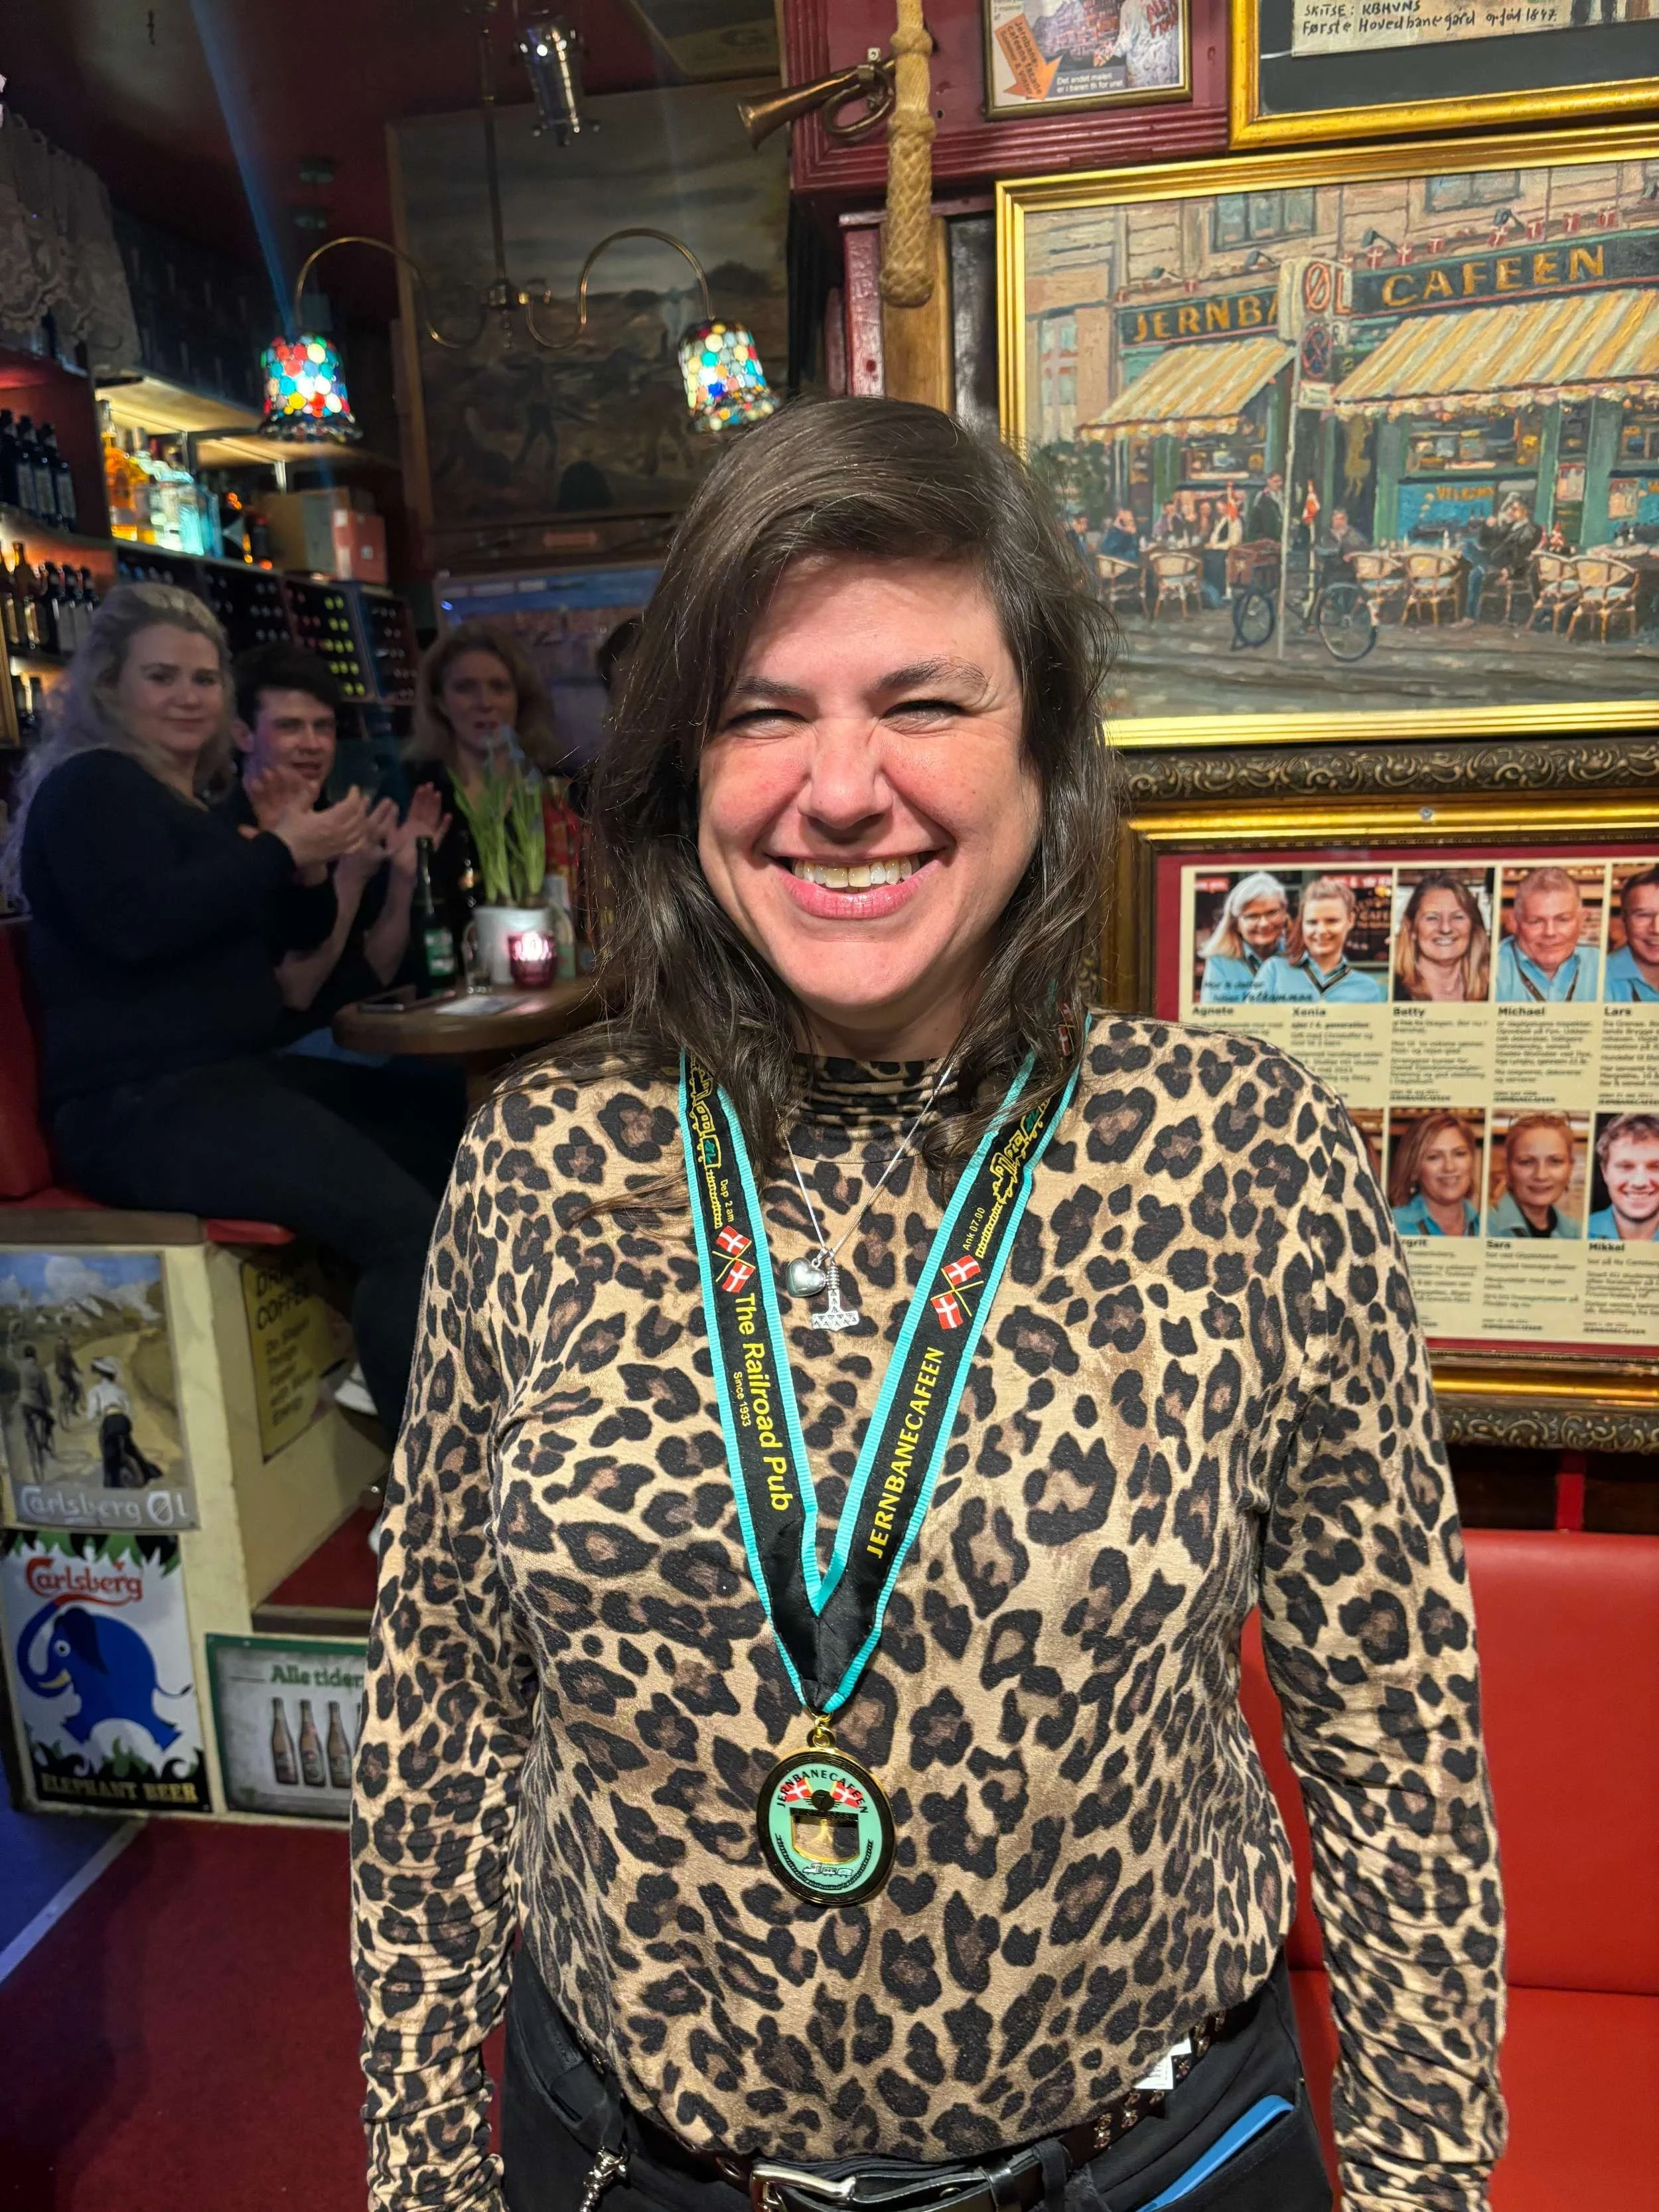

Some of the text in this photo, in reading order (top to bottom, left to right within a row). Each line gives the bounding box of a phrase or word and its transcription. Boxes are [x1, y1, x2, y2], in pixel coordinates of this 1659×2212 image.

[1305, 263, 1350, 315] ØL
[1382, 245, 1606, 307] CAFEEN
[1498, 1006, 1546, 1016] Michael
[1604, 1005, 1632, 1016] Lars
[719, 1179, 735, 1222] Dep 2 am
[962, 1232, 975, 1251] Ank
[733, 1371, 752, 1428] Since 1933
[735, 1292, 794, 1512] The Railroad Pub
[867, 1347, 945, 1559] JERNBANECAFEEN
[21, 1485, 142, 1526] Carlsberg
[25, 1556, 144, 1605] Carlsberg
[270, 1664, 310, 1686] Alle
[40, 1773, 198, 1803] ELEPHANT BEER
[776, 1769, 869, 1814] JERNBANECAFEEN
